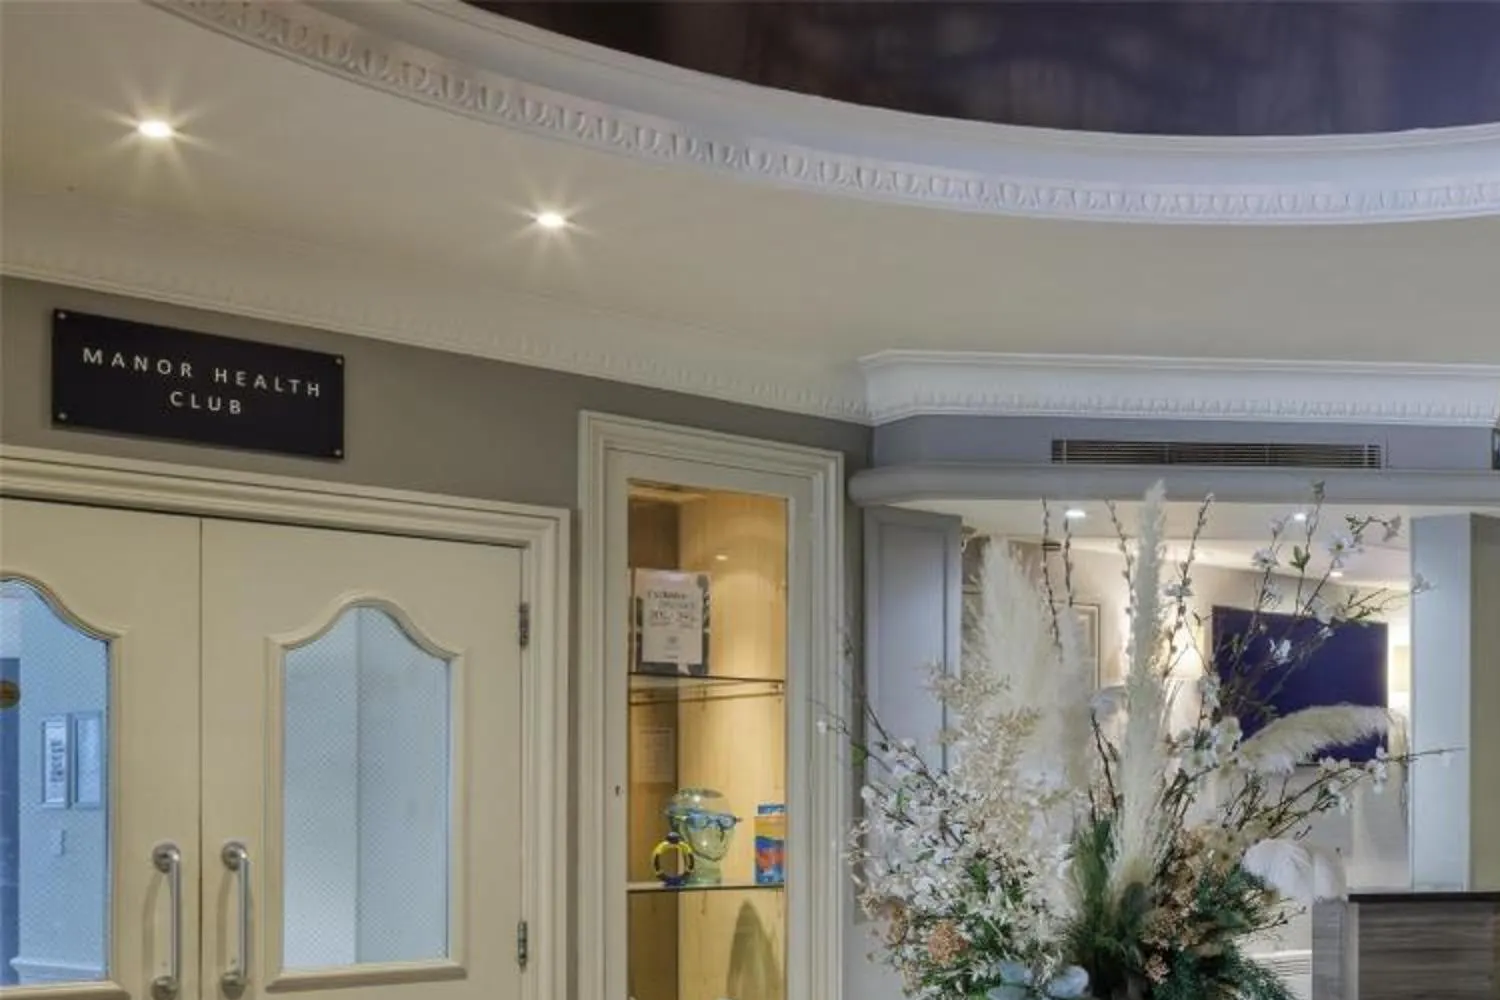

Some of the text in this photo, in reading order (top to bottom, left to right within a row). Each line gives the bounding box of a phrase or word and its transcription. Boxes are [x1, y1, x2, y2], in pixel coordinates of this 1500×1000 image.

[83, 348, 319, 397] MANOR HEALTH
[170, 391, 241, 414] CLUB
